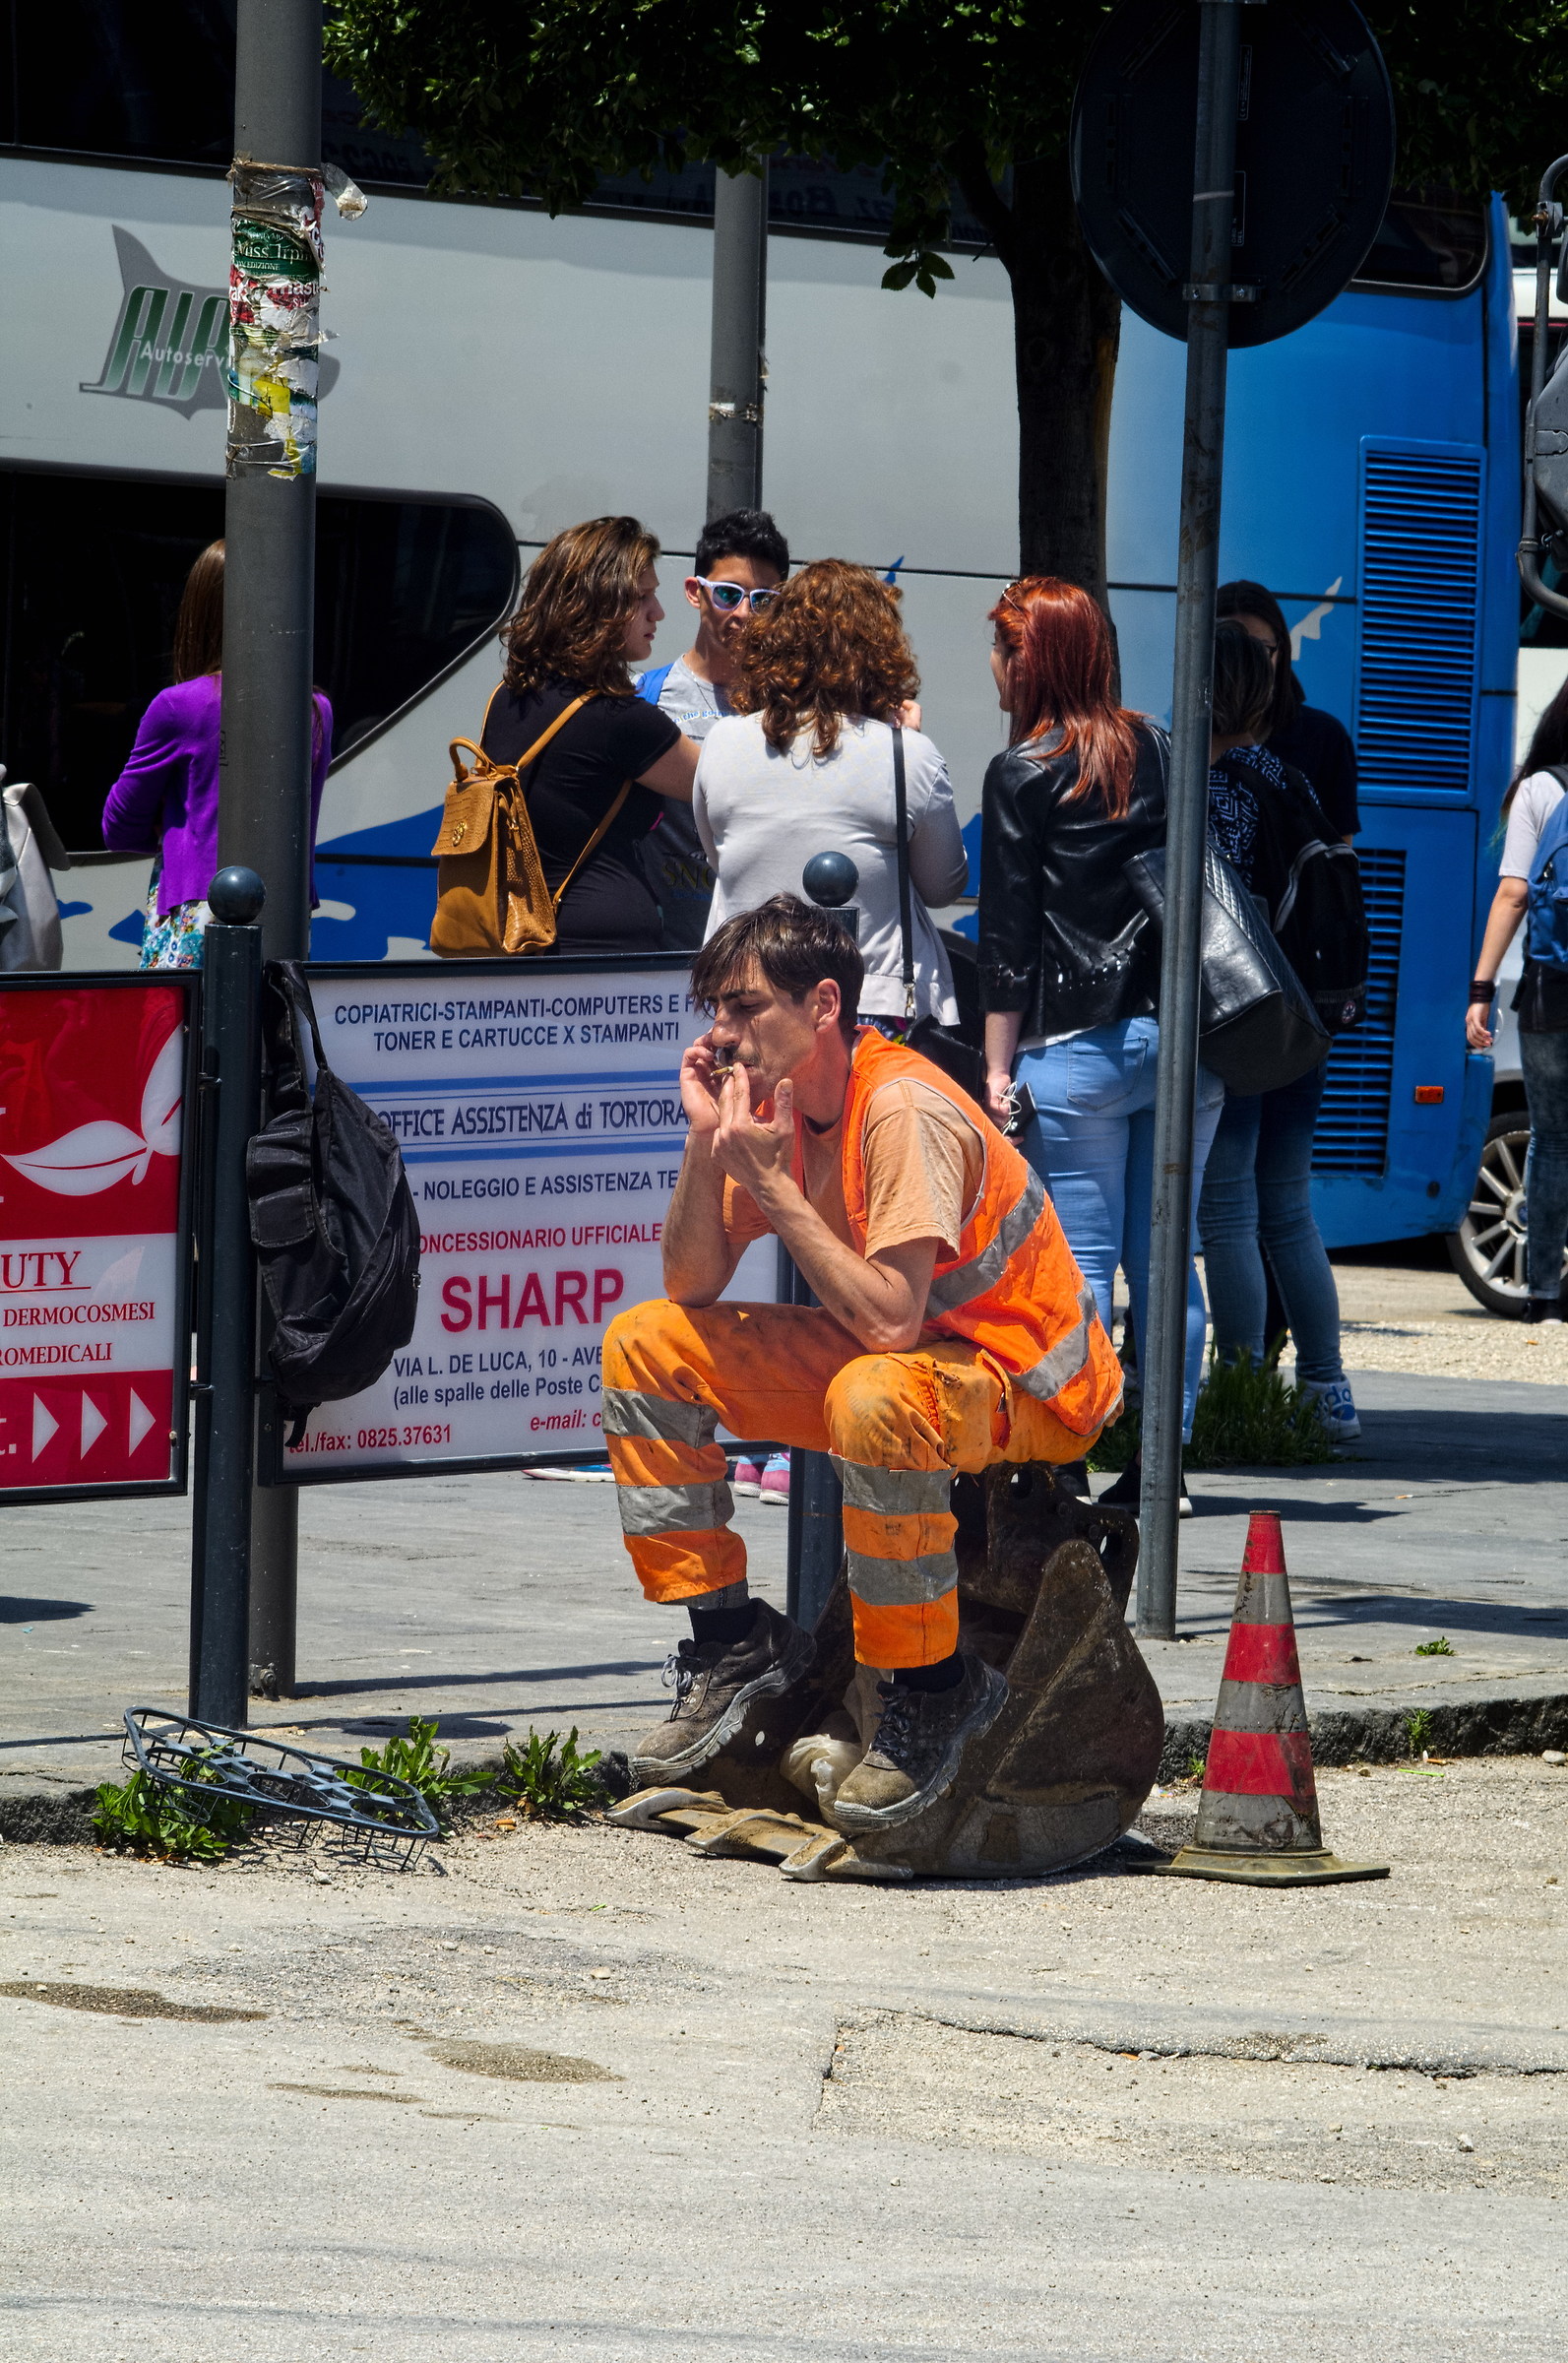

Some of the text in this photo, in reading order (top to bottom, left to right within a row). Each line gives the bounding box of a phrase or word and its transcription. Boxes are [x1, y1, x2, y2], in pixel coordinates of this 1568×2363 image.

[334, 994, 663, 1025] COPIATRICI-STAMPANTI-COMPUTERS
[668, 993, 679, 1013] E
[374, 1022, 679, 1052] TONER E CARTUCCE X STAMPANTI
[451, 1102, 569, 1136] ASSISTENZA
[575, 1102, 593, 1128] di
[599, 1099, 688, 1128] TORTORA
[424, 1178, 520, 1200] NOLEGGIO
[525, 1176, 536, 1196] E
[540, 1171, 653, 1195] ASSISTENZA
[571, 1223, 662, 1246] UFFICIALE
[0, 1250, 81, 1289] UTY
[3, 1302, 155, 1327] DERMOCOSMESI
[440, 1267, 625, 1333] SHARP
[394, 1355, 423, 1378] VIA
[428, 1354, 444, 1376] L.
[449, 1352, 472, 1374] DE
[478, 1349, 532, 1373] LUCA,
[538, 1348, 557, 1368] 10
[394, 1373, 603, 1410] (alle spalle delle Poste C
[531, 1409, 587, 1431] e-mail:
[357, 1424, 451, 1448] 0825.37631
